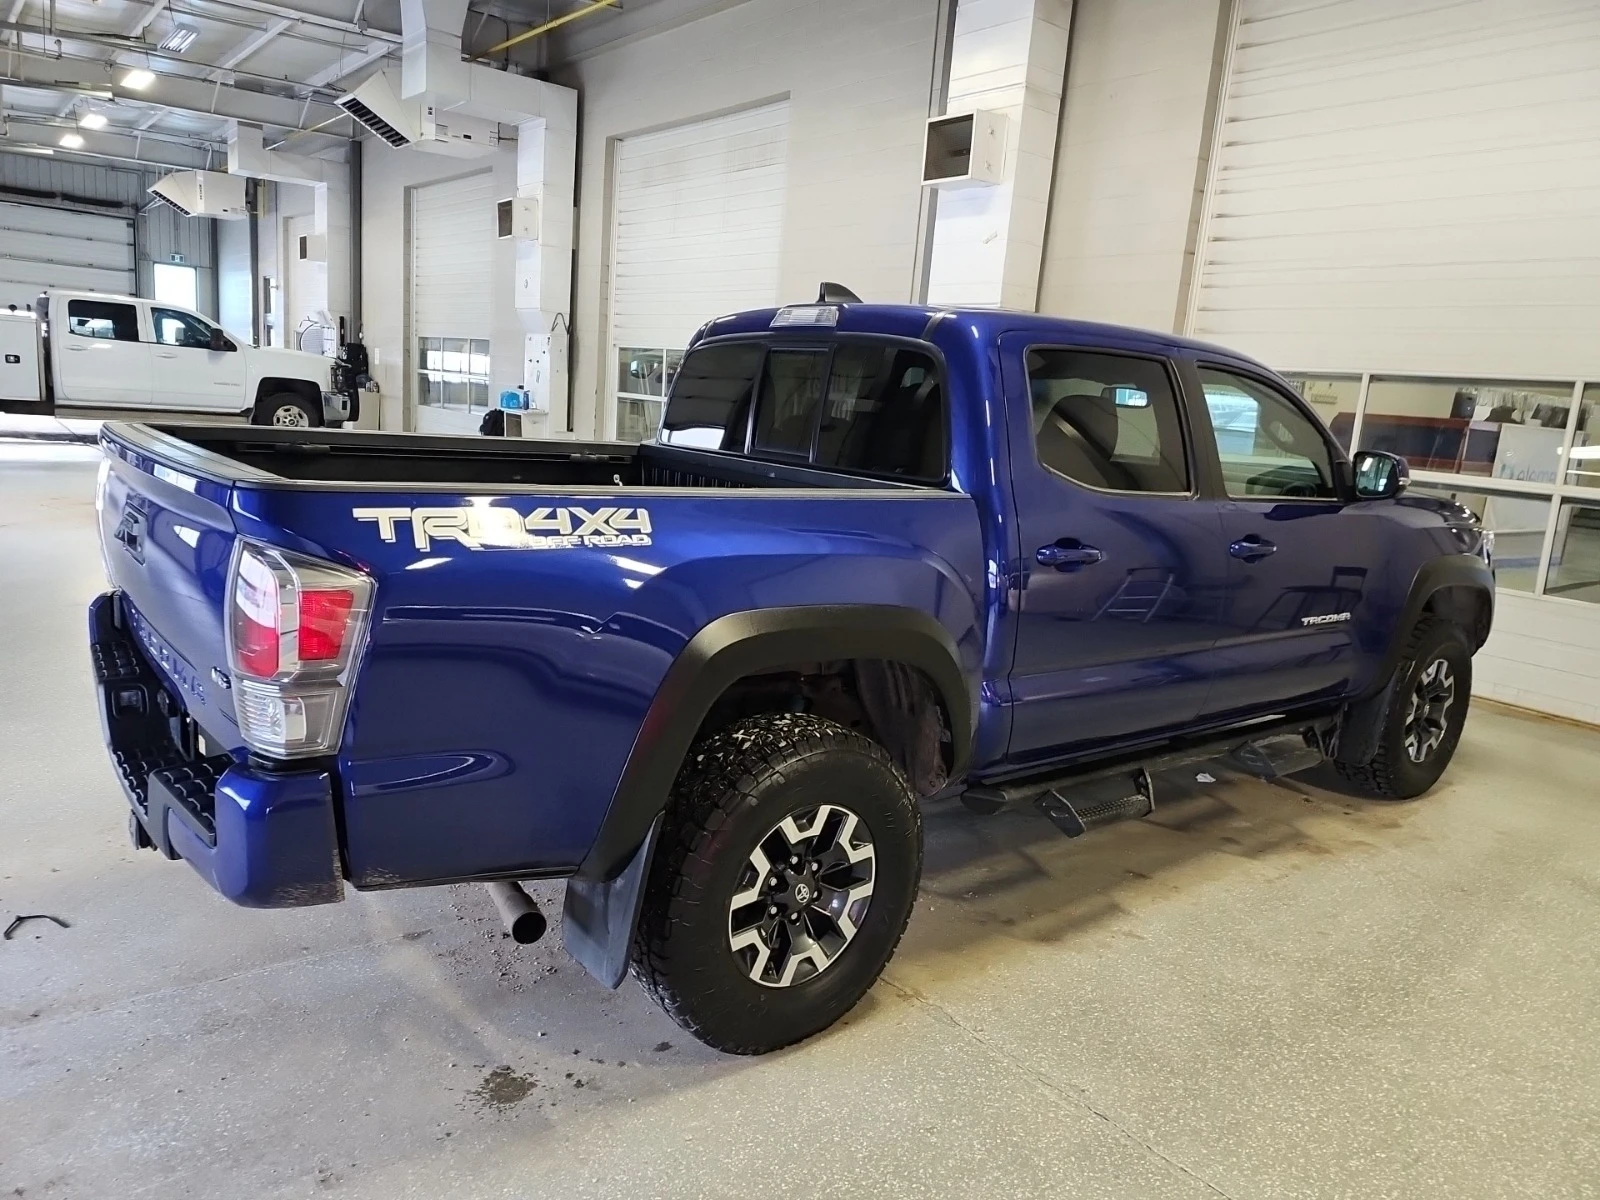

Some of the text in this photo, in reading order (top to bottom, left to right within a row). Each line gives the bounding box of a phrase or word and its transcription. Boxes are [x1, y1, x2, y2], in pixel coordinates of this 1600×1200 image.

[352, 506, 525, 552] TRD
[532, 533, 653, 549] OFF ROAD
